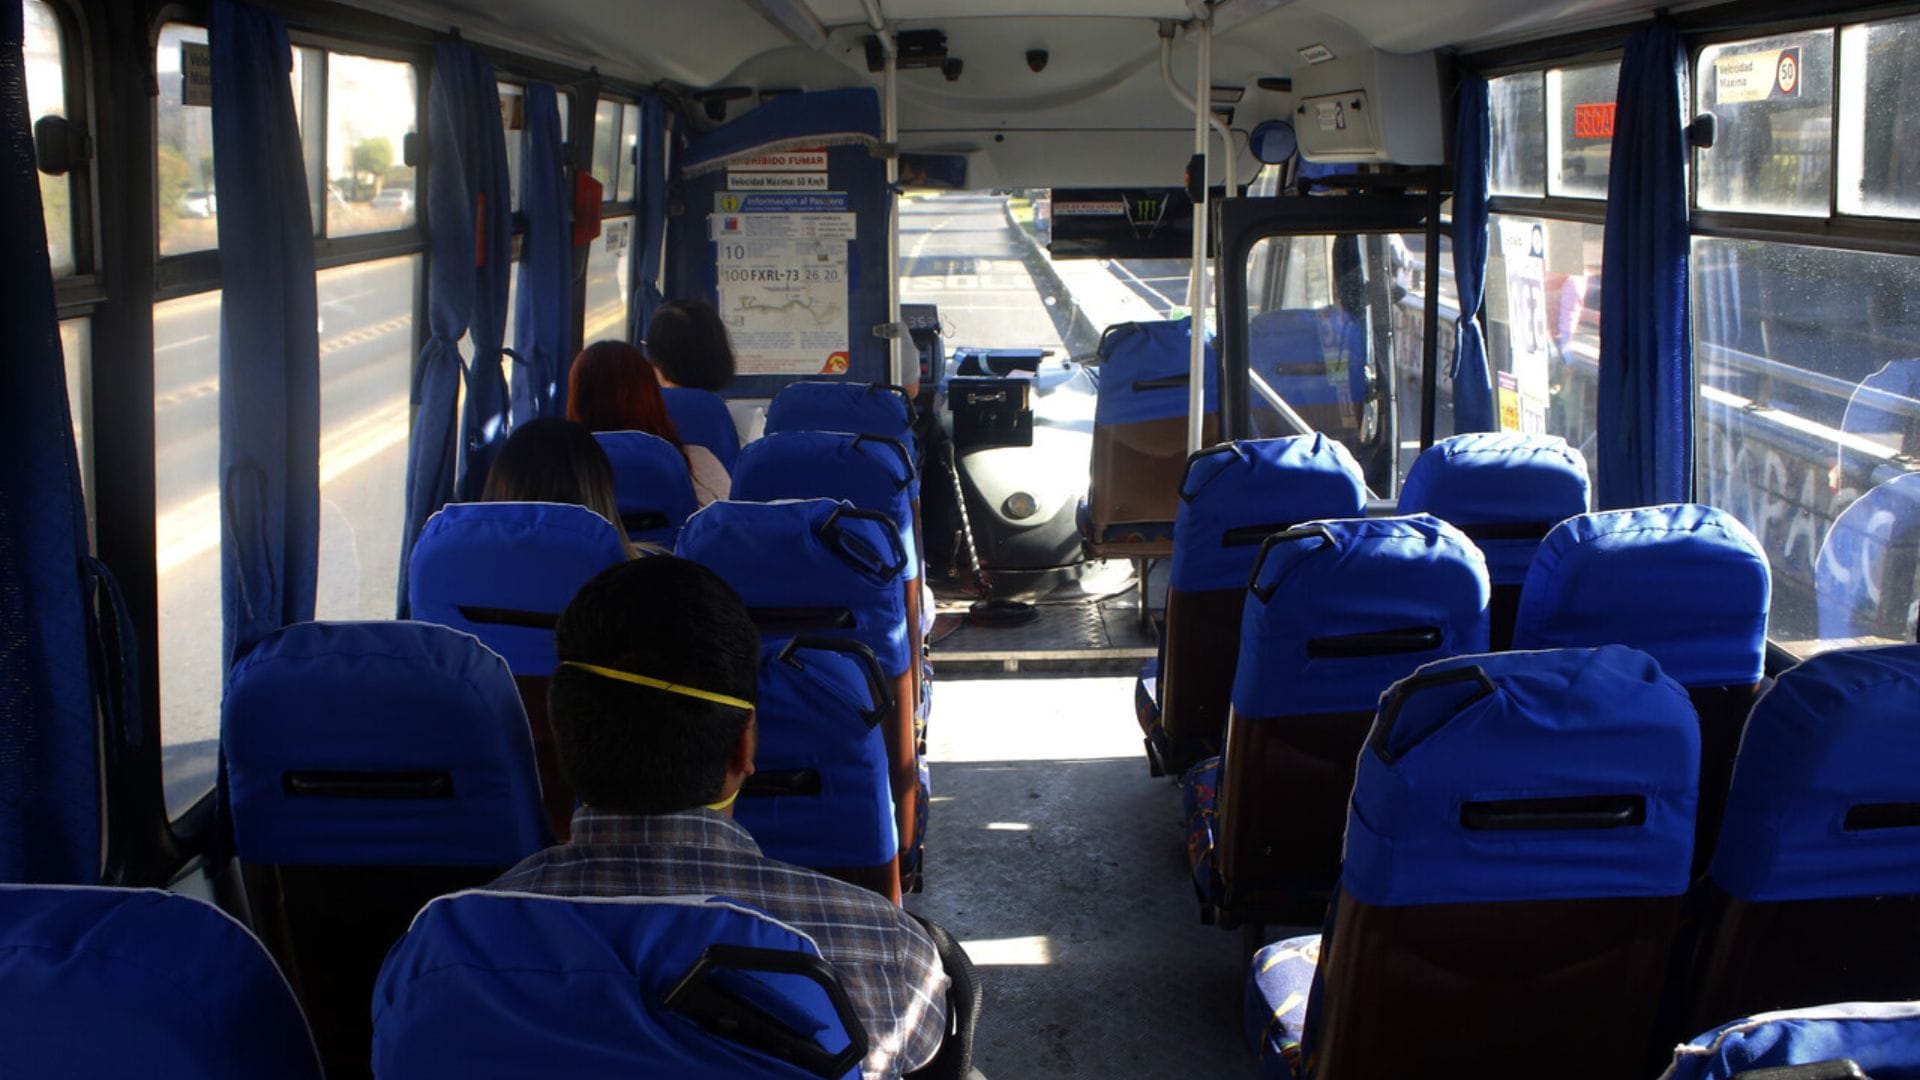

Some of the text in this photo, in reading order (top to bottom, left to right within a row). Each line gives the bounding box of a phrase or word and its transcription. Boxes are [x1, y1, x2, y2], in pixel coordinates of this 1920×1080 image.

[1719, 62, 1794, 80] Velocidad 50
[788, 156, 824, 165] FUMAR
[730, 176, 765, 186] Velocidad
[796, 177, 806, 186] 50
[799, 197, 808, 206] al
[725, 245, 745, 260] 10
[750, 269, 800, 281] FXRL-73
[805, 270, 820, 281] 26
[824, 270, 838, 281] 20
